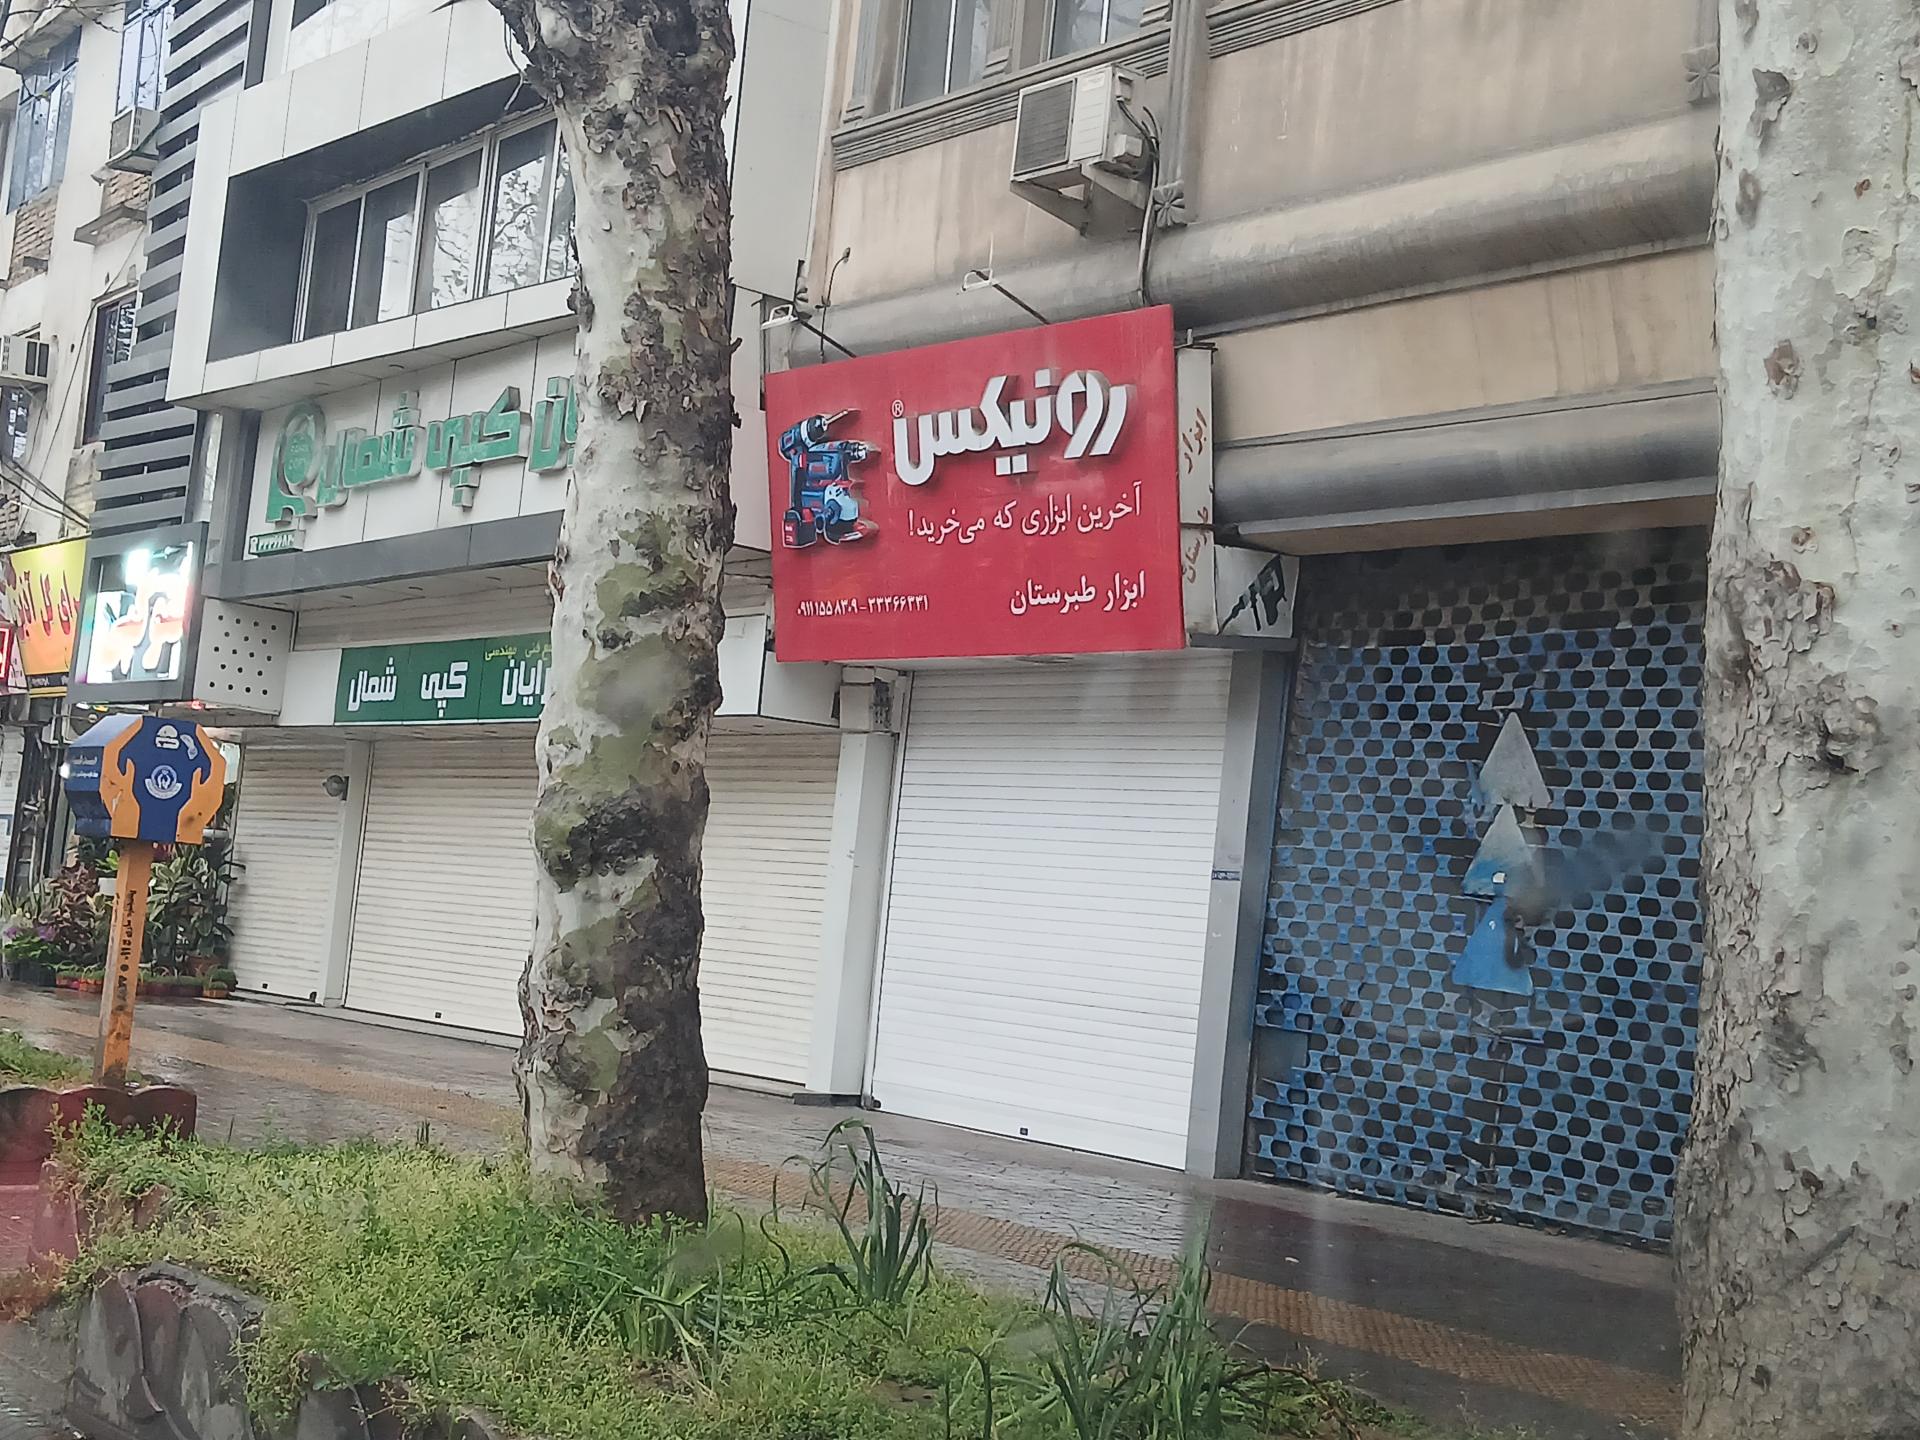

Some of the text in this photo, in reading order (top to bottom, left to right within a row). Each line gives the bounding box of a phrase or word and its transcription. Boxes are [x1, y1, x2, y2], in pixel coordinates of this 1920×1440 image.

[426, 386, 523, 508] کپی
[893, 369, 1130, 485] رونیکس
[992, 498, 1016, 529] که
[1022, 494, 1072, 538] ابزاری
[1077, 480, 1141, 534] آخرین
[1010, 569, 1146, 617] ابزار طبرستان
[348, 657, 397, 712] شمال
[421, 661, 469, 718] کپی
